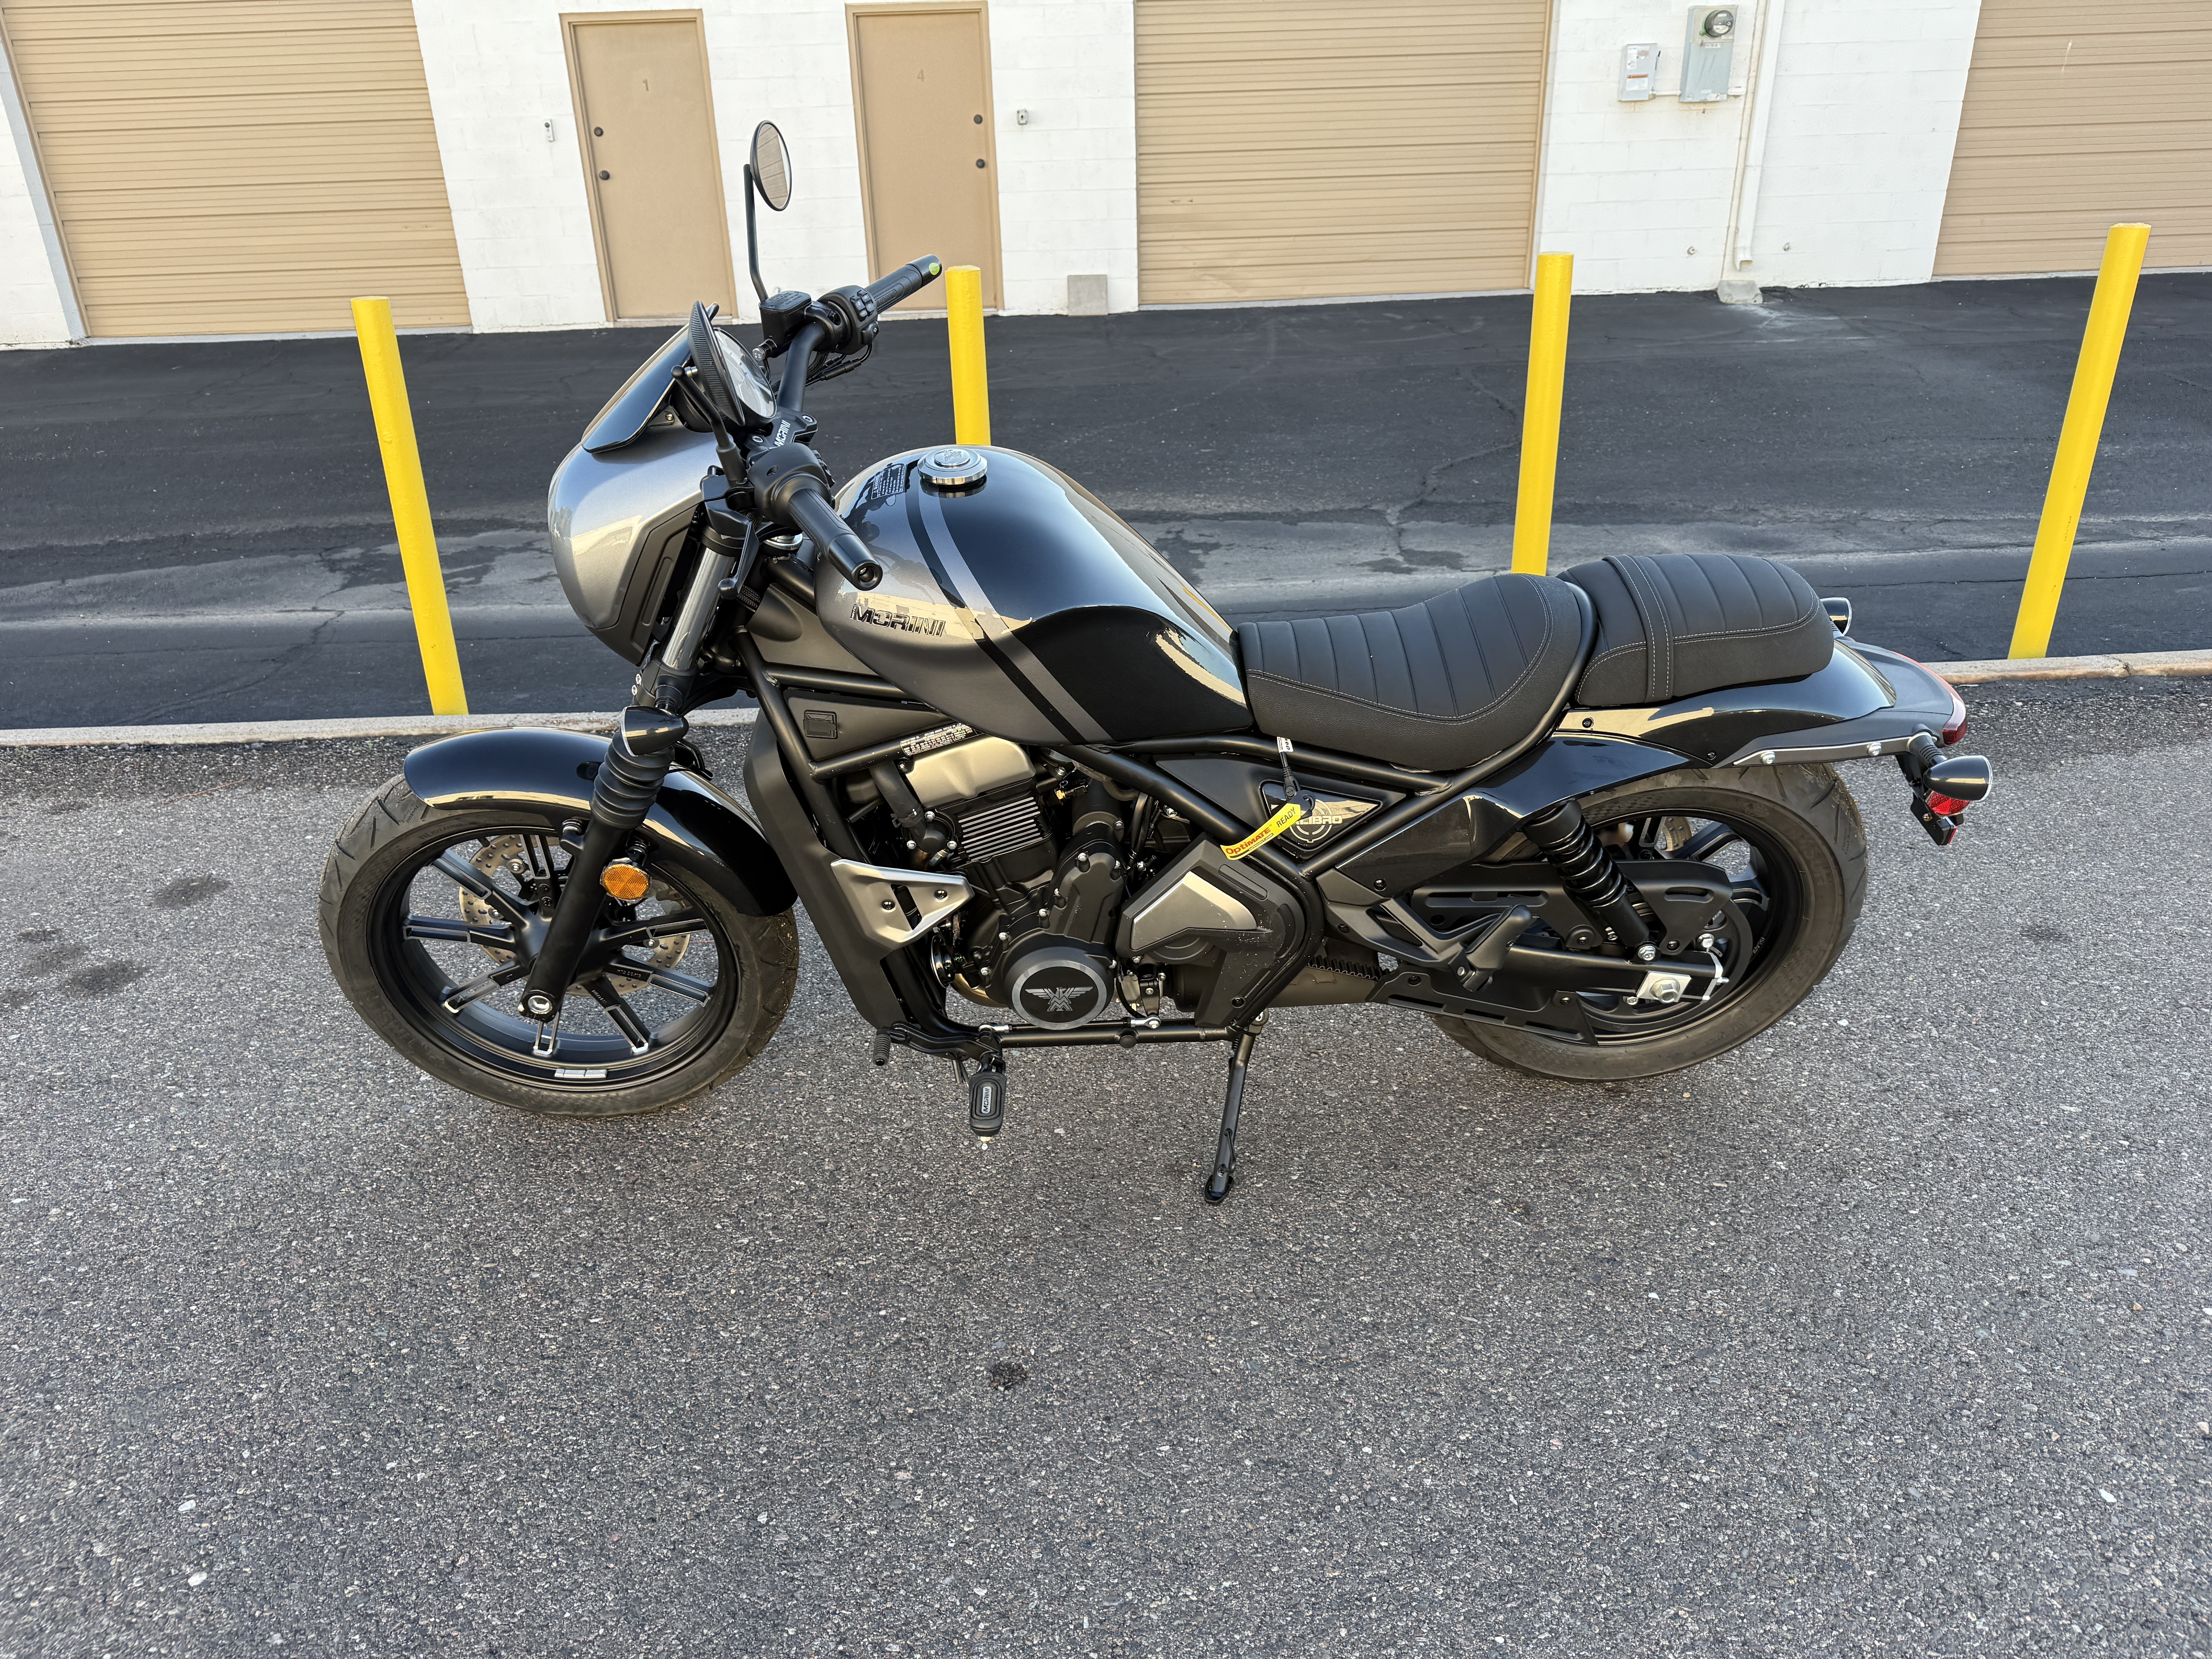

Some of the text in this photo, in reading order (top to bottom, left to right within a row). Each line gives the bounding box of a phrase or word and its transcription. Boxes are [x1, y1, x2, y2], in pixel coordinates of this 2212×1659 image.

[917, 69, 924, 82] 4
[642, 79, 649, 91] 1
[774, 419, 791, 447] MORINI
[850, 604, 946, 637] MORINI
[1276, 807, 1296, 828] READY
[1295, 815, 1343, 825] LIBRO
